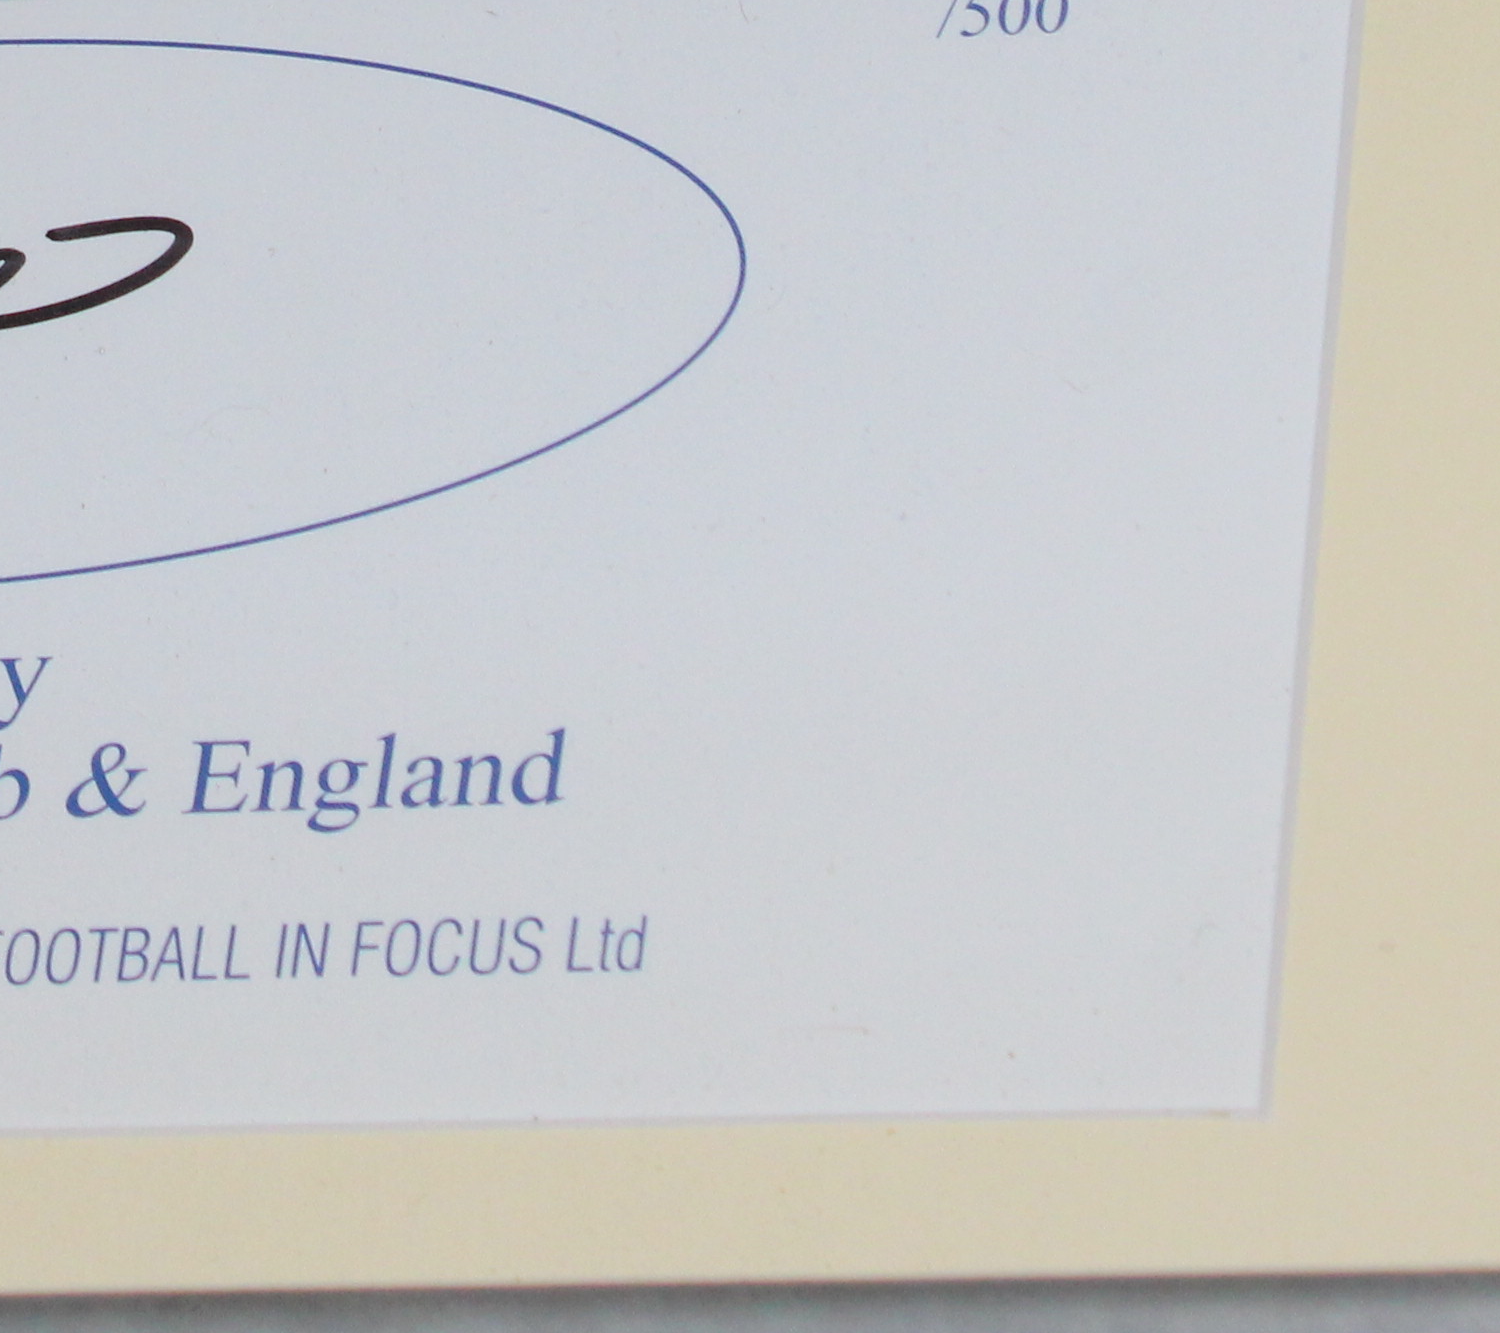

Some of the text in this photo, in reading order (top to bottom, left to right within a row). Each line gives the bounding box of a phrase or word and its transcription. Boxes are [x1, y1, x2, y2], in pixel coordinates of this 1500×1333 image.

[65, 742, 147, 820] &
[182, 727, 566, 835] England
[275, 922, 331, 979] IN
[350, 915, 545, 979] FOCUS
[566, 915, 648, 973] Ltd
